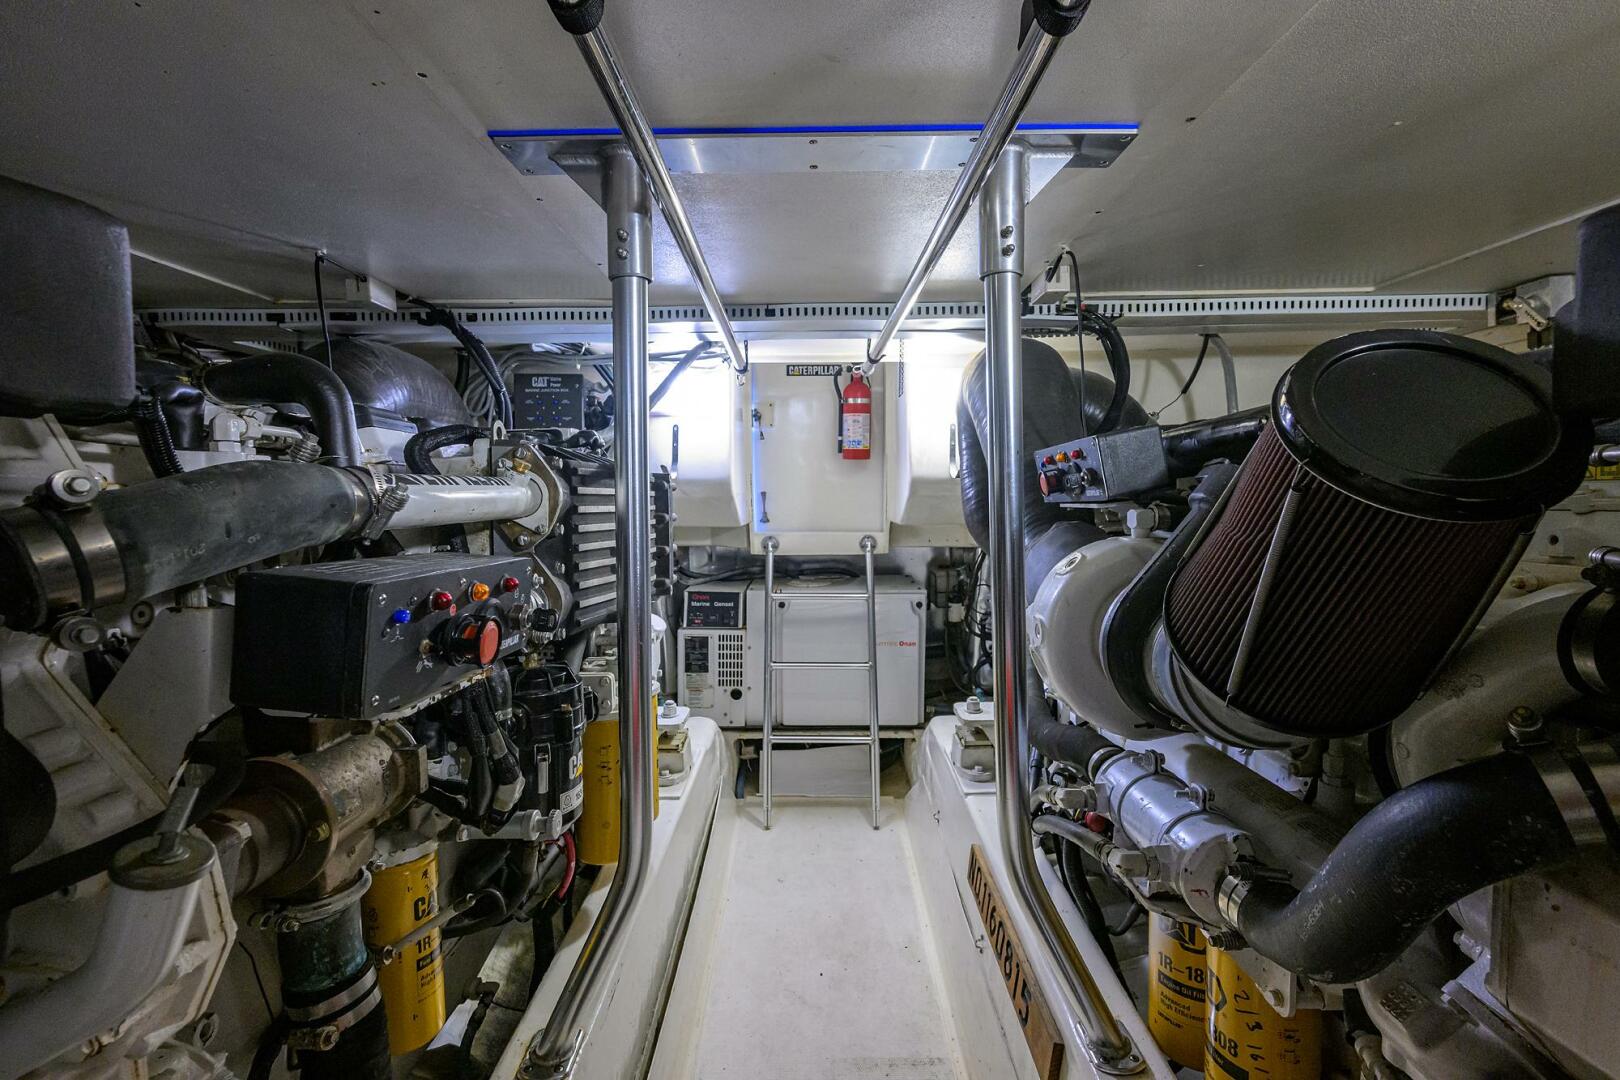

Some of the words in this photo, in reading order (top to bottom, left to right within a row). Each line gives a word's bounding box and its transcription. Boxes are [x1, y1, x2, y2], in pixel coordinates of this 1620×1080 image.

[531, 376, 549, 388] CAT
[568, 750, 584, 780] CA
[413, 894, 438, 922] CA
[1159, 992, 1191, 1012] Advanced
